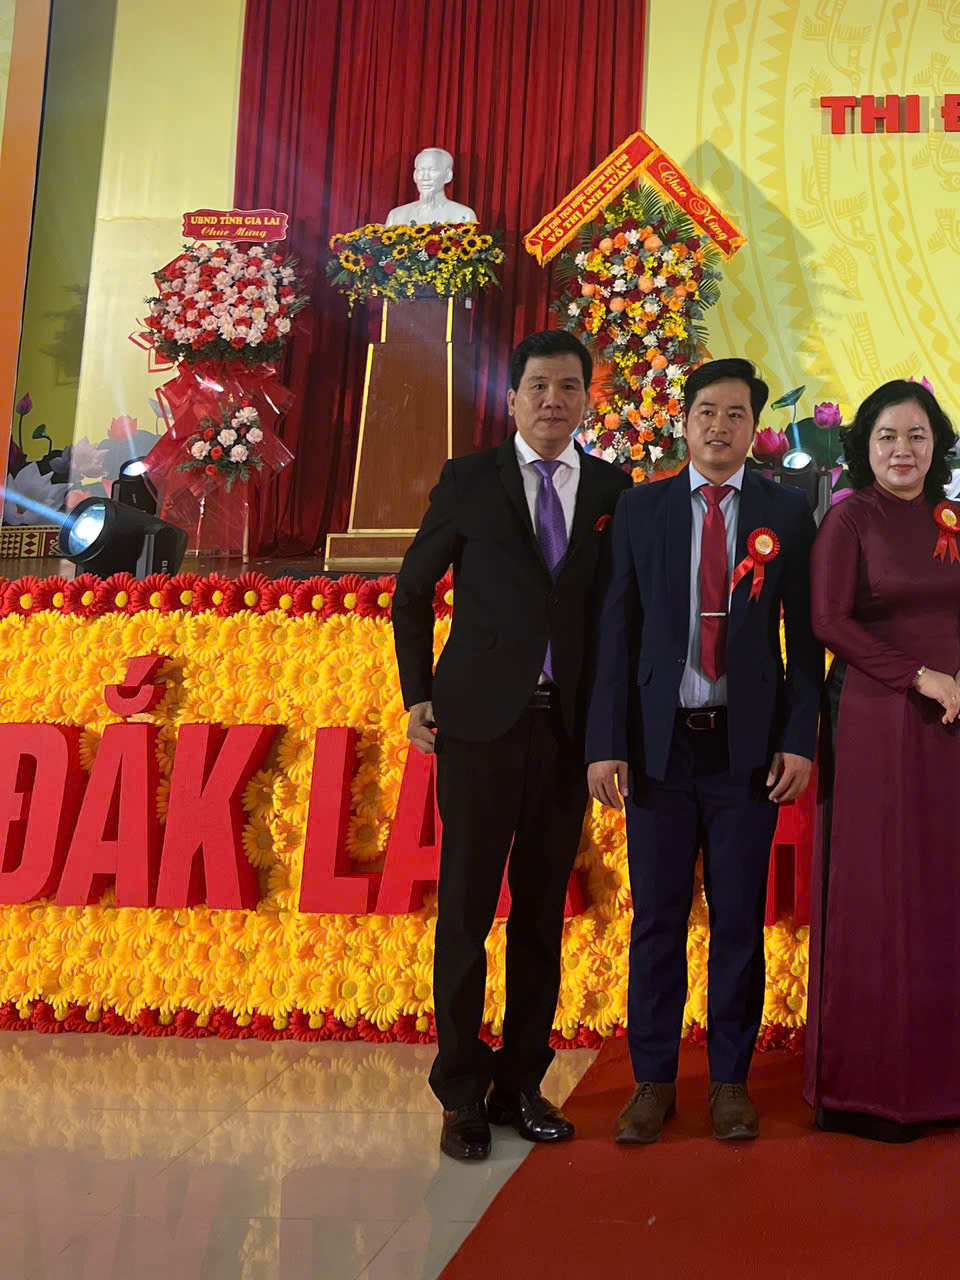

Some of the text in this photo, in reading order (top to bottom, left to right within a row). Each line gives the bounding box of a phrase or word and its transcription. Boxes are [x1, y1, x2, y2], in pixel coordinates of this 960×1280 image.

[820, 94, 921, 134] THI
[191, 213, 280, 225] UBND TỈNH GIA LAI
[547, 162, 632, 242] VÕ THỊ ÁNH XUÂN
[0, 650, 286, 910] ĐẮK
